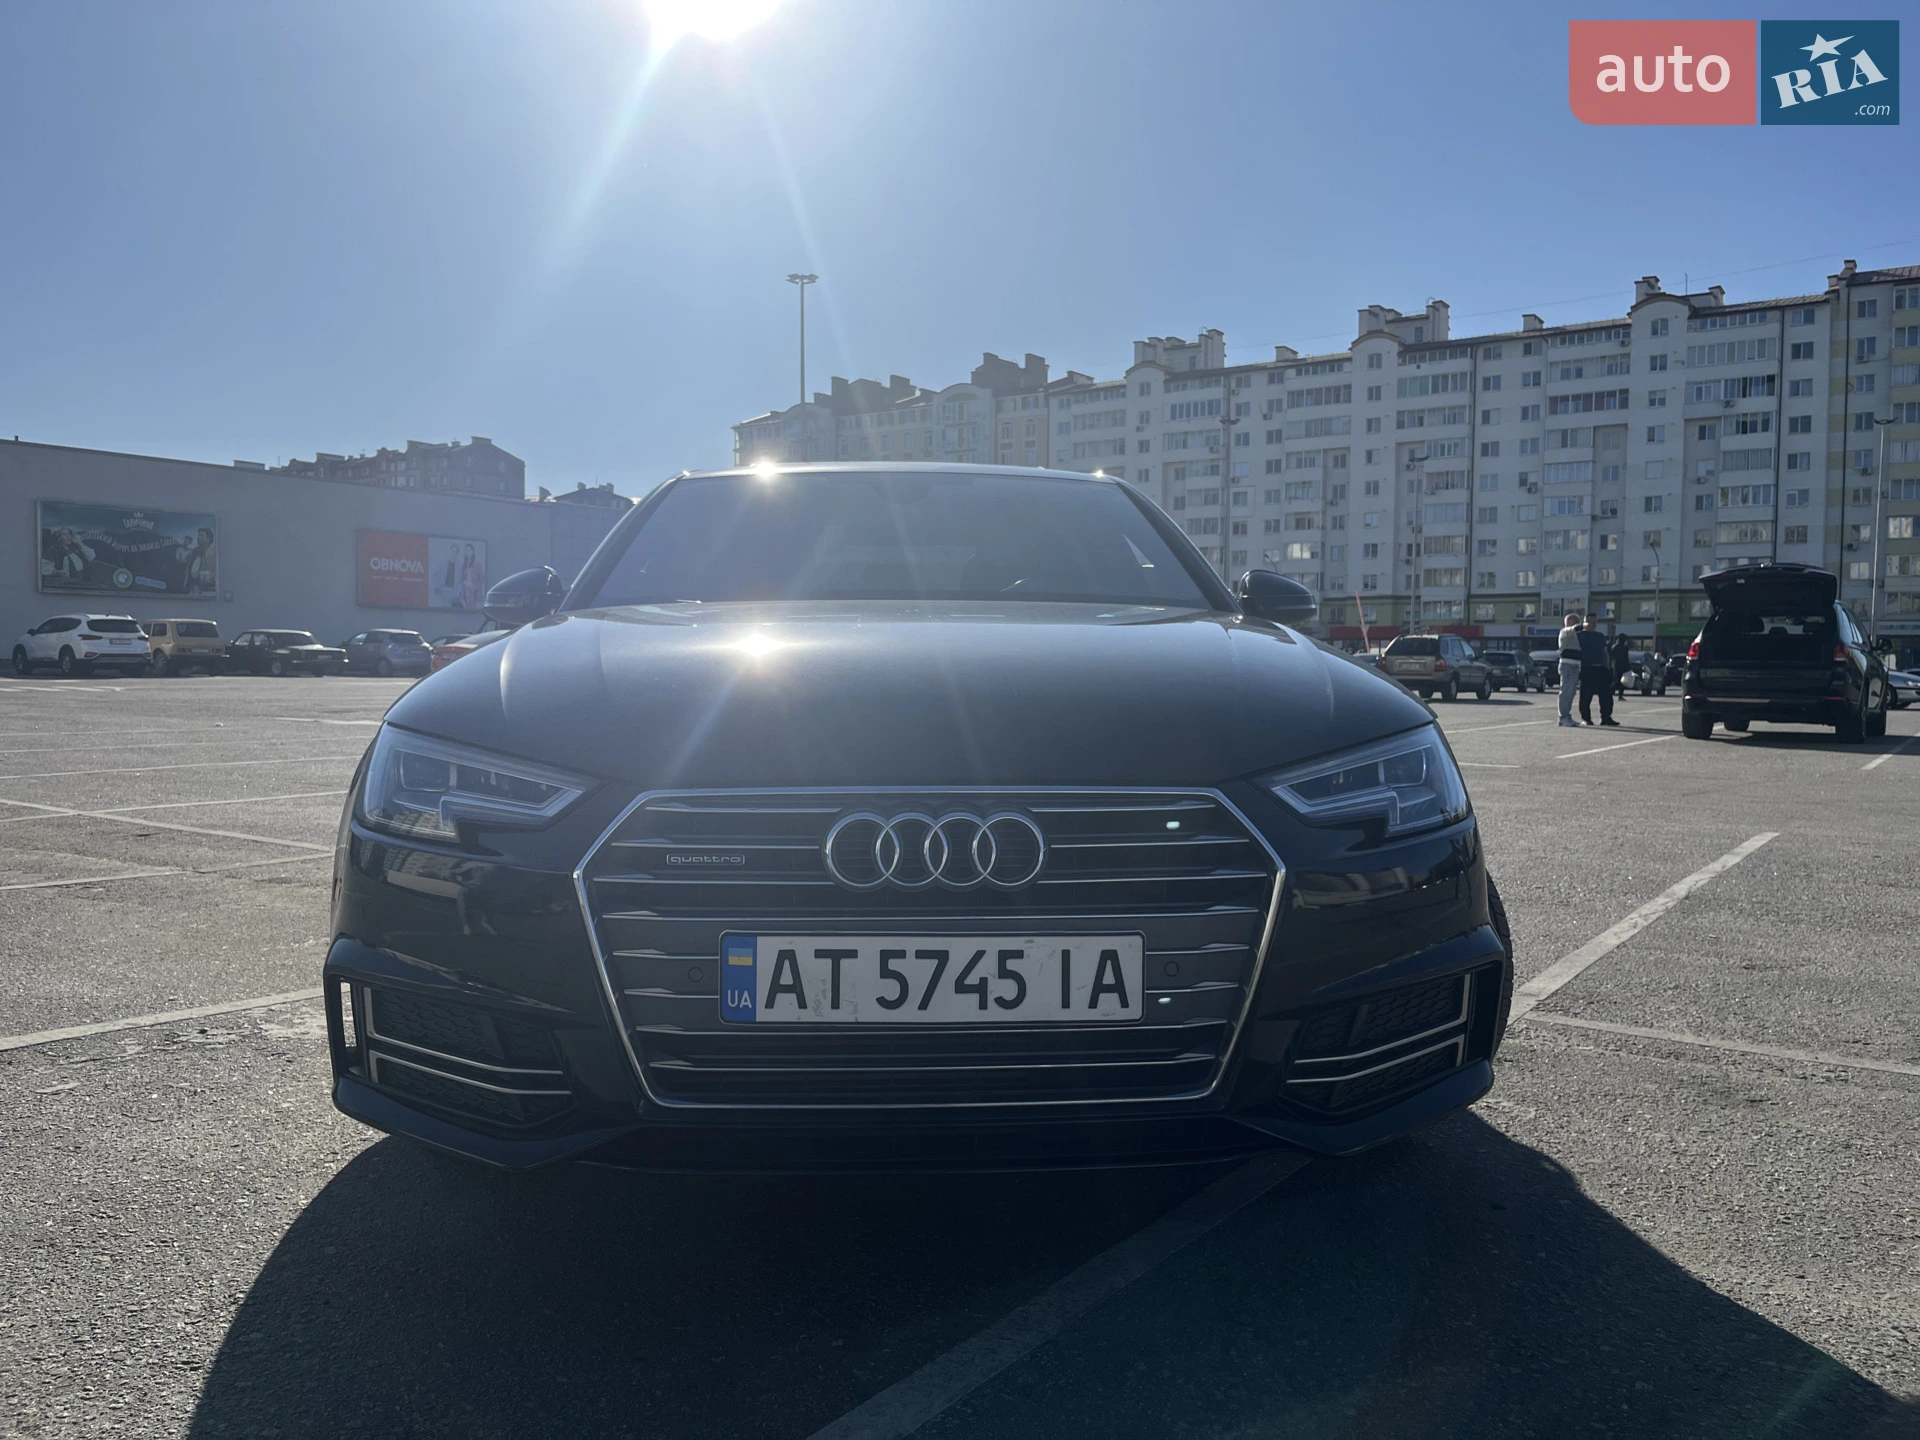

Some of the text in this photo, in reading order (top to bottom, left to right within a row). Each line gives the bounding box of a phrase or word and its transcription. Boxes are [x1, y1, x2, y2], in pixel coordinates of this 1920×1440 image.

[122, 518, 155, 530] ГАЛИЧИНА
[369, 557, 425, 574] OBNOVA
[670, 855, 741, 864] quattro
[764, 949, 1130, 1011] AT 5745 IA
[727, 990, 753, 1008] UA
